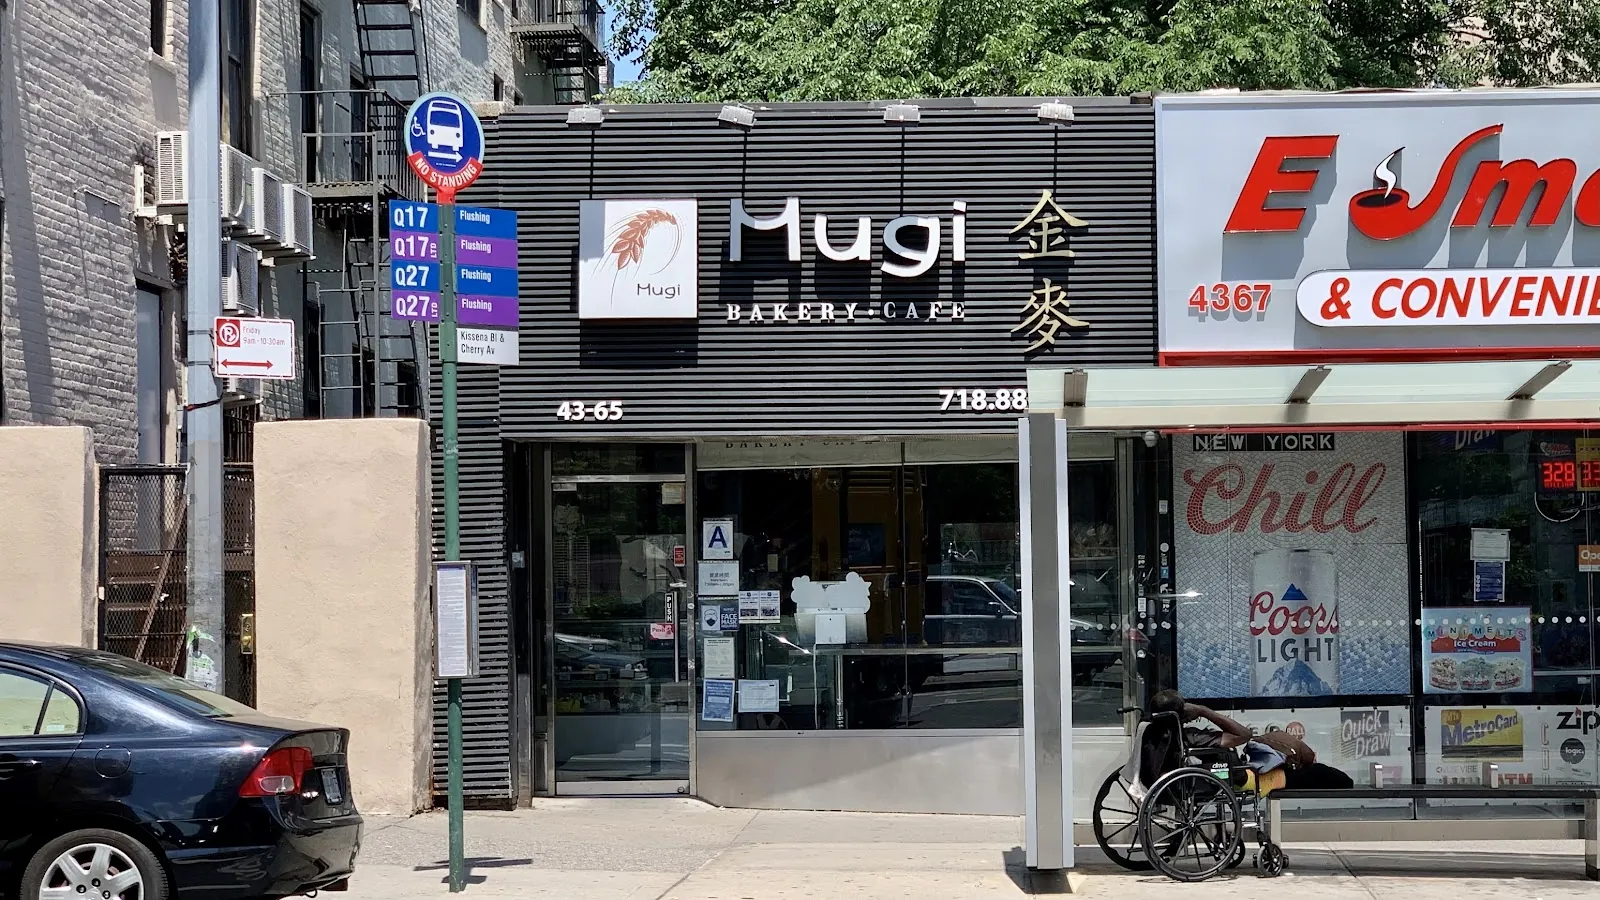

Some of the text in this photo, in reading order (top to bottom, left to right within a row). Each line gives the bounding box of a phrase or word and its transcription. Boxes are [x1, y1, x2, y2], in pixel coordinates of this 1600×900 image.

[415, 157, 478, 187] NO STANDING
[1223, 134, 1340, 235] E
[393, 205, 429, 228] Q17
[460, 209, 491, 225] Flushing
[394, 235, 430, 257] Q17
[461, 239, 492, 254] Flushing
[728, 196, 967, 278] Mugi
[395, 264, 430, 287] Q27
[461, 268, 492, 283] Flushing
[636, 283, 681, 299] Mugi
[1187, 283, 1273, 313] 4367
[1320, 277, 1352, 320] &
[395, 294, 431, 317] Q27
[461, 298, 493, 312] Flushing
[726, 301, 965, 321] BAKERY CAFE
[242, 326, 261, 335] Friday
[460, 330, 488, 342] Kissena
[499, 333, 505, 343] &
[461, 343, 495, 356] Cherry Av
[556, 400, 624, 421] 43-65
[938, 388, 1028, 411] 718.88
[1195, 434, 1333, 450] NEW YORK
[1543, 461, 1575, 482] 328
[1183, 461, 1387, 535] Chill
[708, 525, 728, 548] A
[1249, 590, 1340, 636] Coors
[1257, 637, 1334, 662] LIGHT
[1454, 640, 1497, 648] Ice Cream
[1341, 708, 1382, 742] Quick
[1441, 711, 1518, 746] MetroCard
[1355, 731, 1392, 760] Draw
